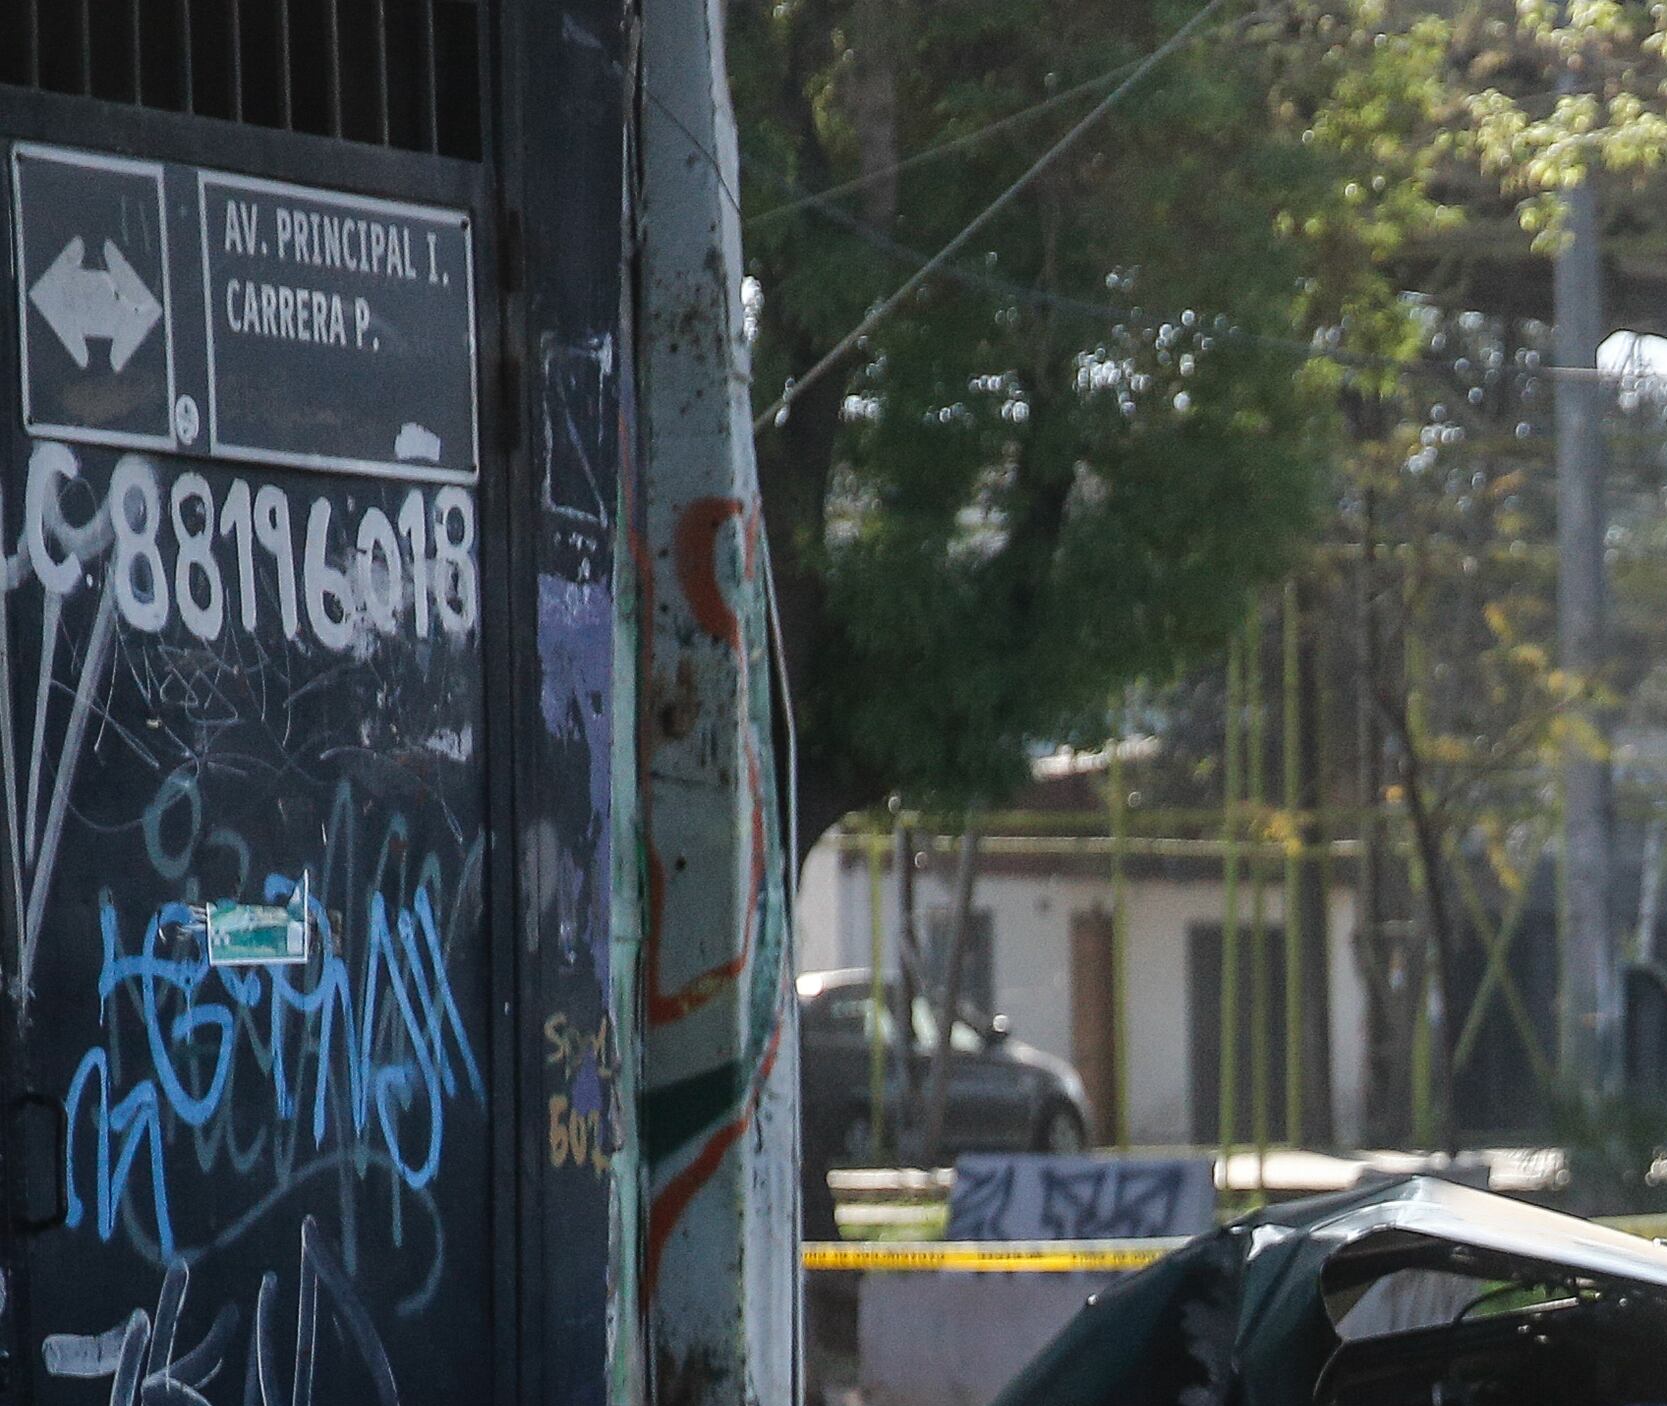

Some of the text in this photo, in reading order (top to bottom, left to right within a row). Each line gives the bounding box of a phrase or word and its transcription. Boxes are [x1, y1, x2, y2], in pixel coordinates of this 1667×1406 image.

[225, 200, 450, 287] AV. PRINCIPAL I.
[226, 278, 380, 352] CARRERA P.
